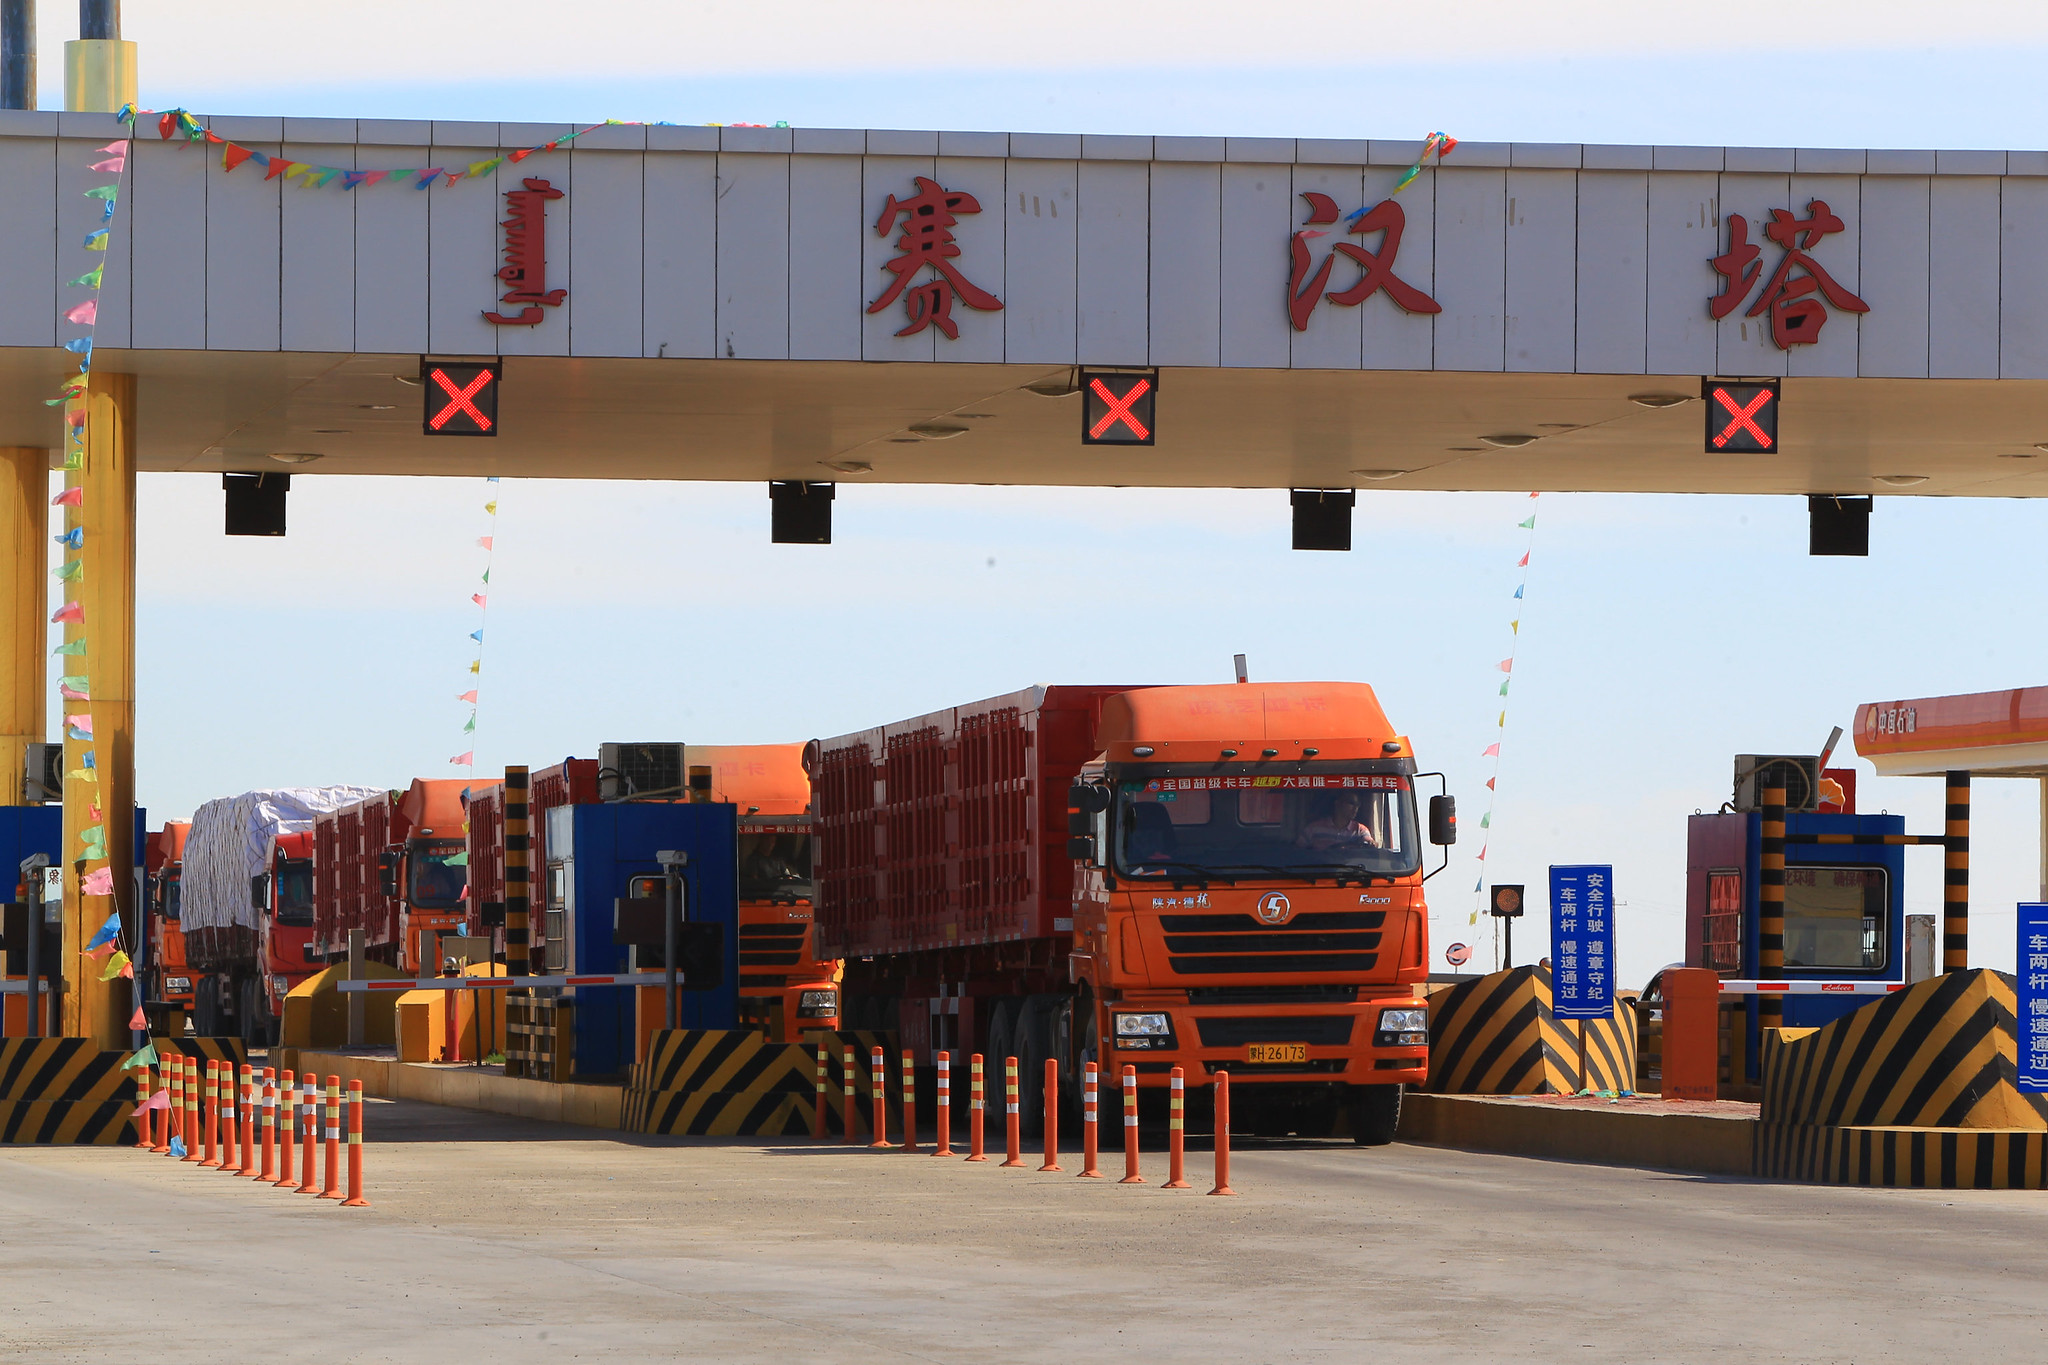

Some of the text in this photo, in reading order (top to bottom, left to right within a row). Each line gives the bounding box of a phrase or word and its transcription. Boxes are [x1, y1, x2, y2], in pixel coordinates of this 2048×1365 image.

[1879, 707, 1916, 735] 中国石油
[1162, 776, 1398, 791] 全国超级卡车越野大赛唯一指定赛车
[1560, 877, 1578, 1000] 一车两杆 慢速通过
[1586, 873, 1605, 1000] 安全行驶 遵章守纪
[2028, 920, 2048, 1070] 一车两杆 慢速通过
